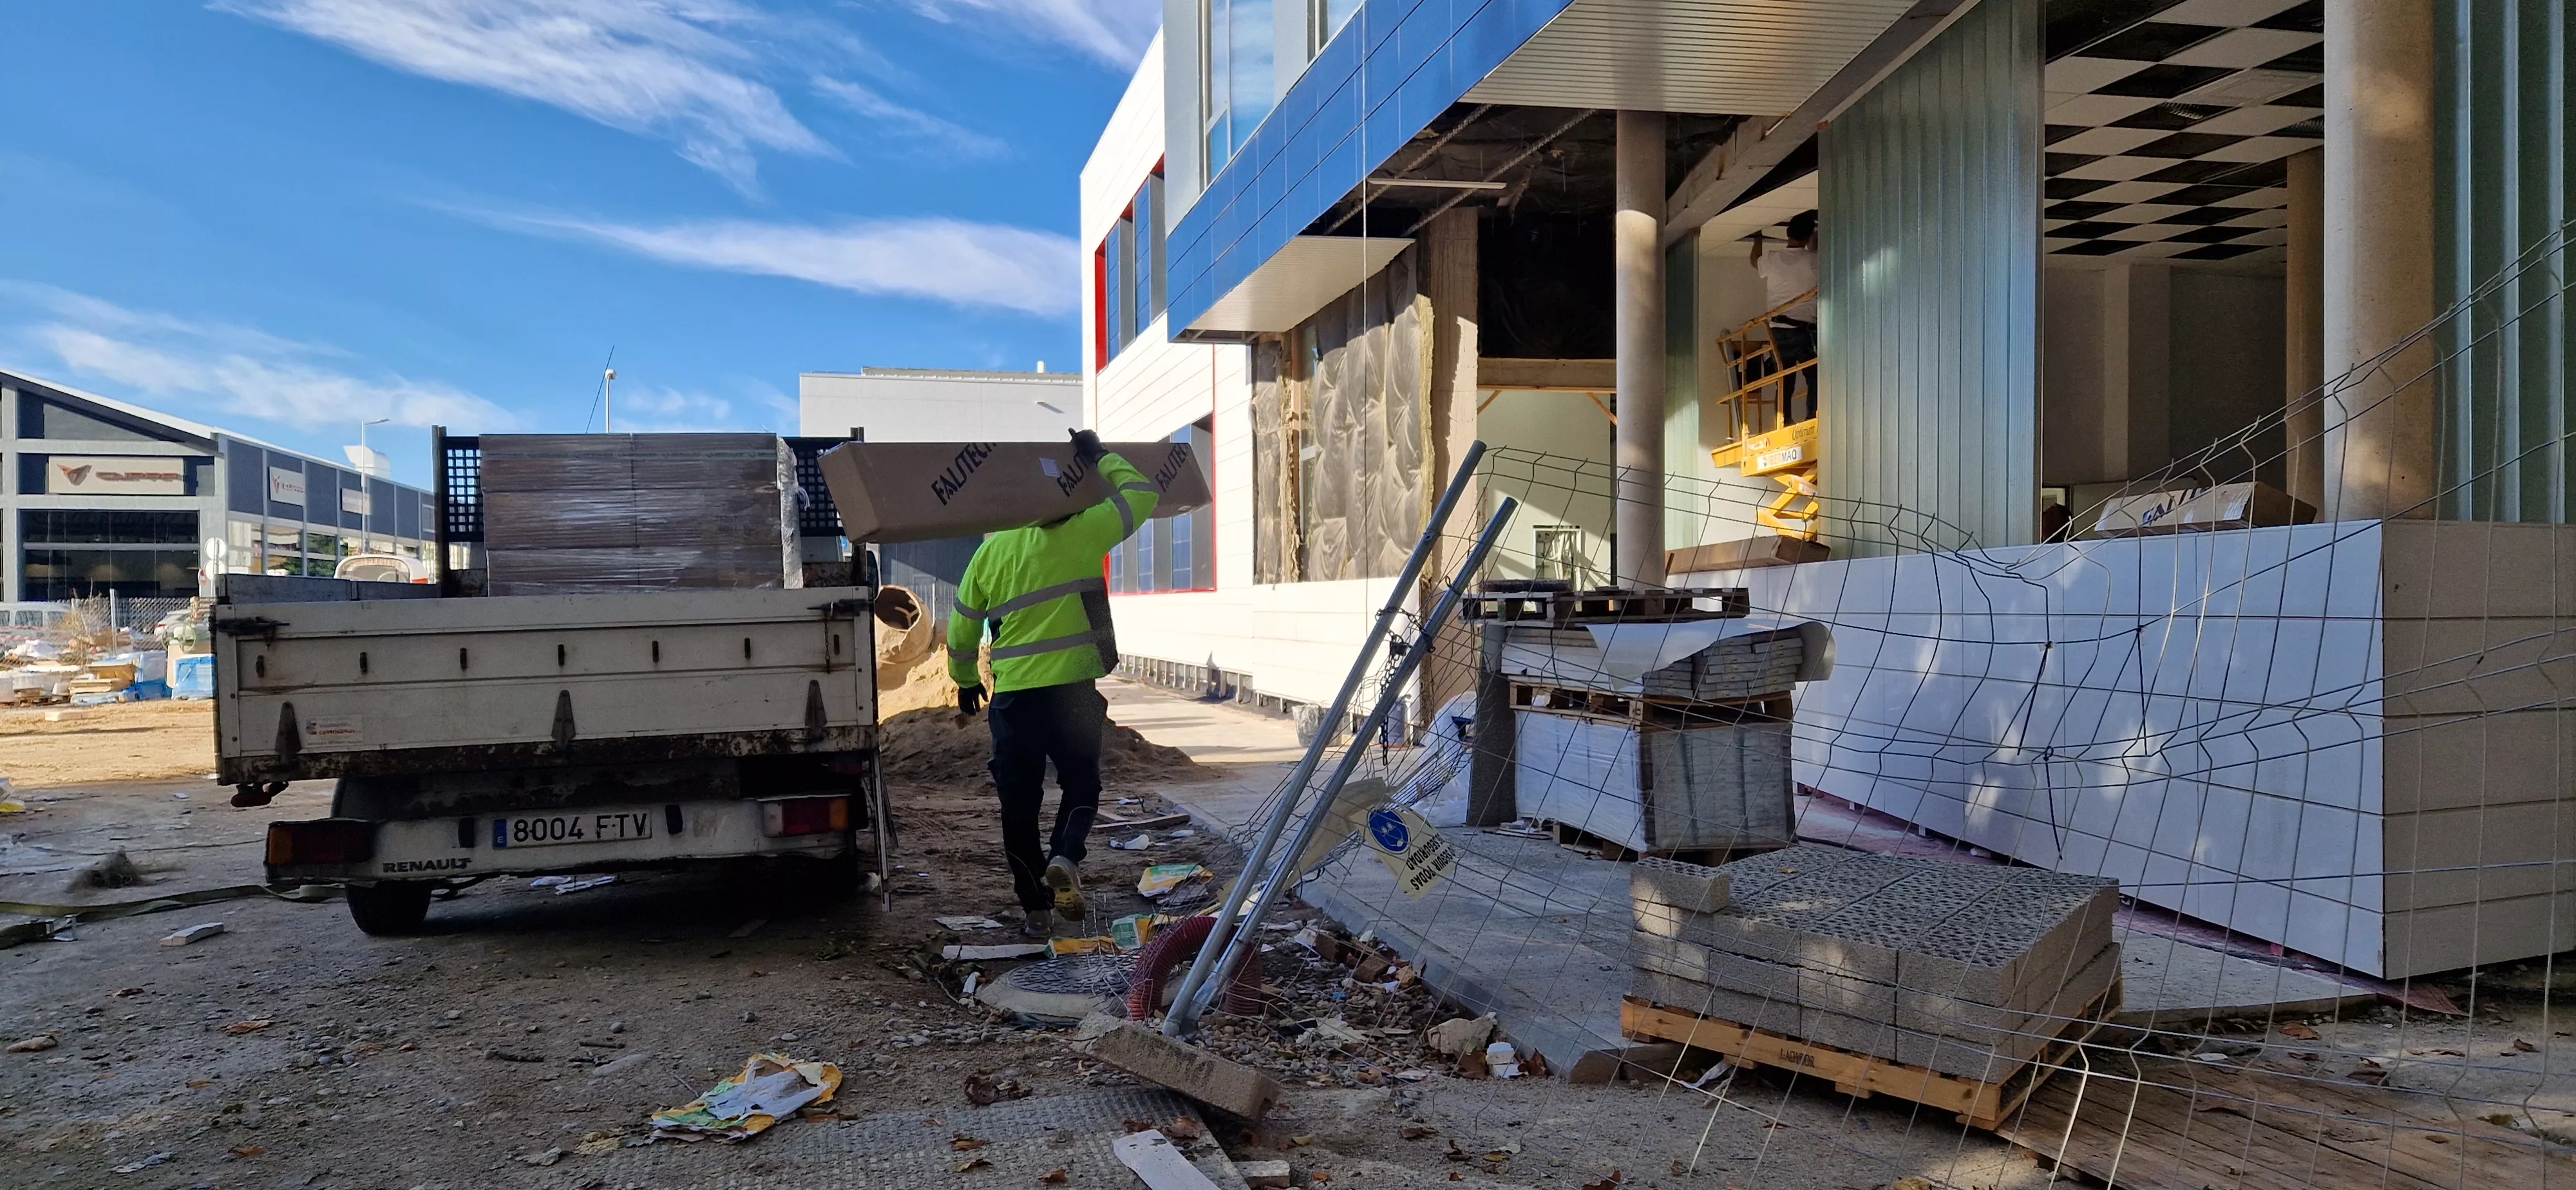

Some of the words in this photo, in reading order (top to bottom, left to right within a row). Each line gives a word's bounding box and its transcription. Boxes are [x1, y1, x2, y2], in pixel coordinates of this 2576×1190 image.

[513, 816, 583, 842] 8004
[596, 813, 647, 839] FTV
[383, 857, 473, 873] RENAULT
[1406, 836, 1441, 871] SEGURIDAD
[1410, 865, 1437, 891] TODAS
